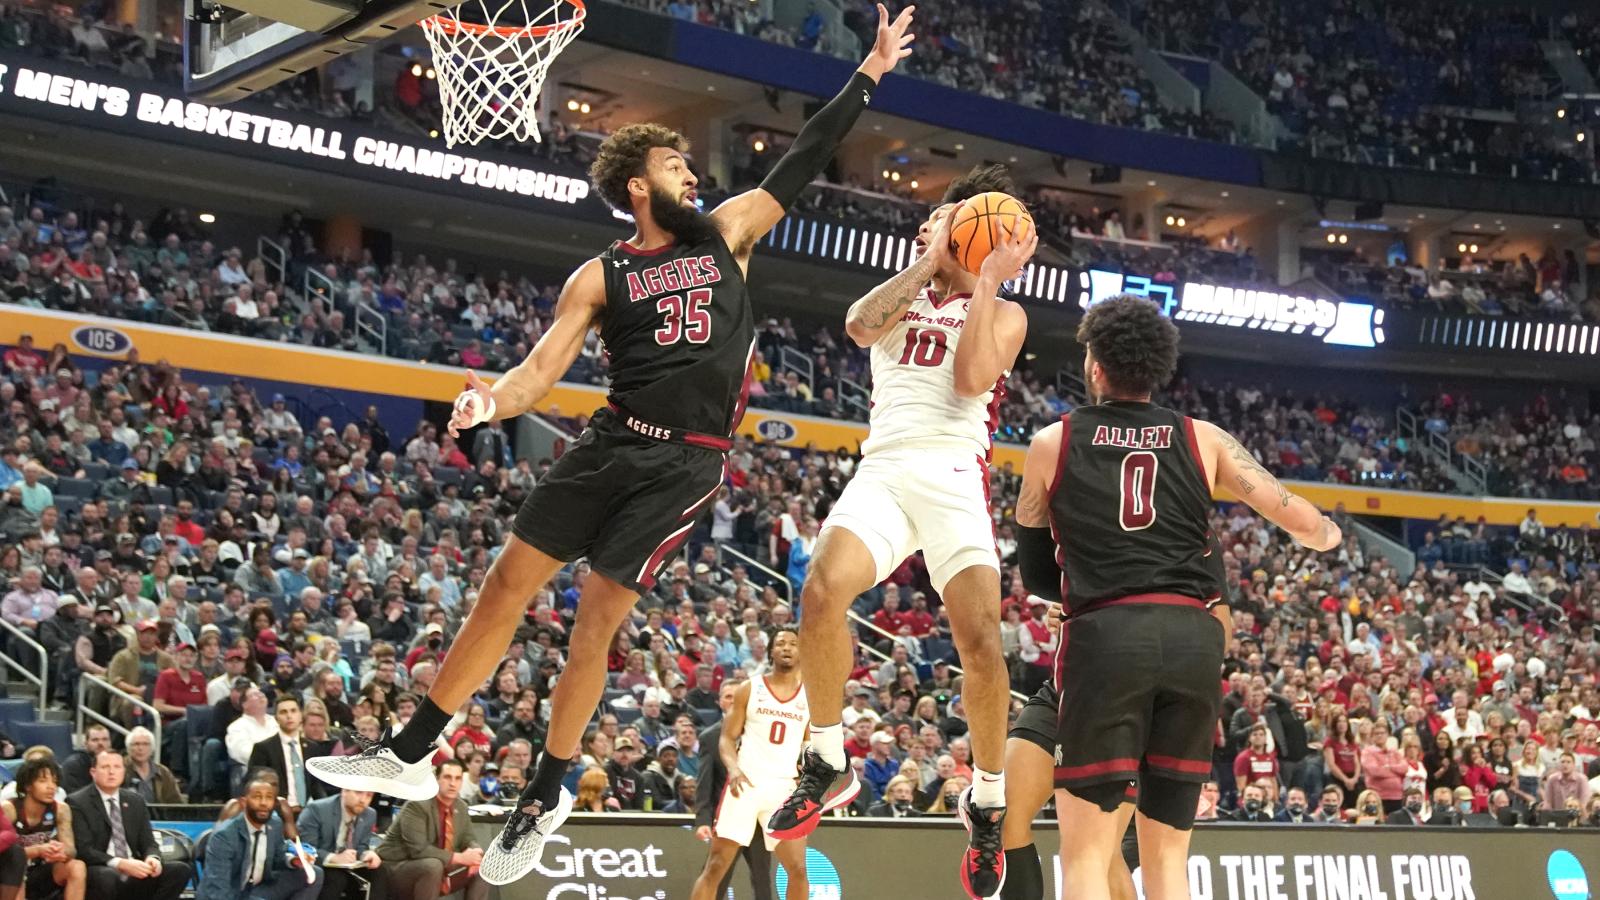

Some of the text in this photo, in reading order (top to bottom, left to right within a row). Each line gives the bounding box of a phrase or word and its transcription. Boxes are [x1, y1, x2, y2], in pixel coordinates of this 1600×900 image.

[14, 68, 130, 117] MEN'S
[136, 92, 346, 160] BASKETBALL
[353, 136, 589, 204] CHAMPIONSHIP
[626, 255, 721, 302] AGGIES
[655, 287, 712, 345] 35
[899, 310, 965, 328] RKANSA
[88, 330, 116, 350] 105
[898, 327, 947, 367] 10
[626, 416, 671, 440] AGGIES
[1092, 425, 1173, 449] ALLEN
[1119, 451, 1158, 531] 0
[756, 707, 803, 722] ARKANSAS
[769, 720, 786, 745] 0
[535, 834, 667, 878] Great
[1220, 855, 1288, 900] THE
[1294, 855, 1388, 900] FINAL
[1391, 855, 1476, 900] FOUR
